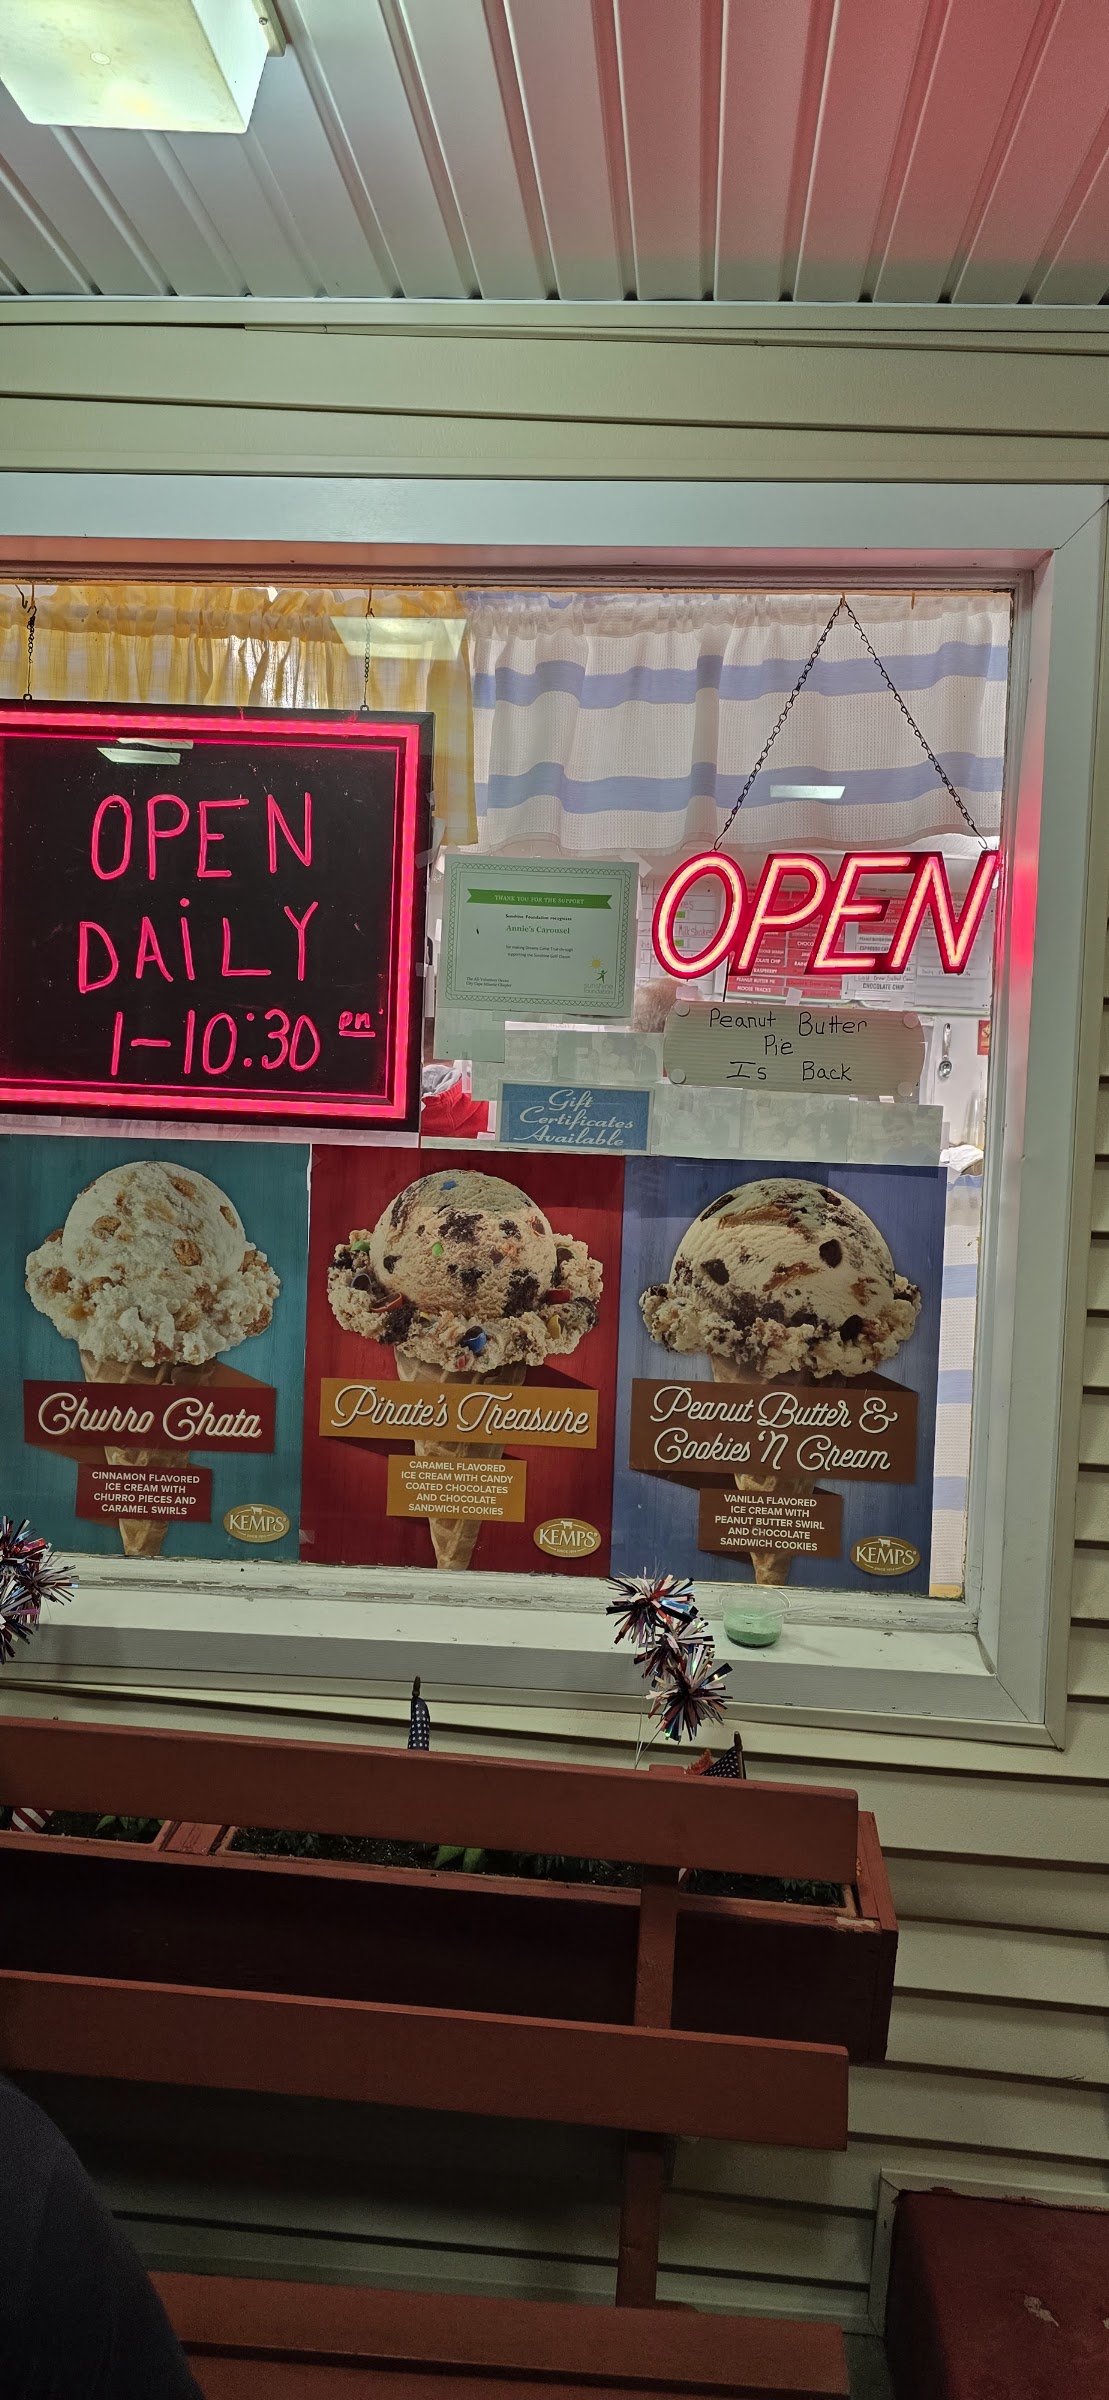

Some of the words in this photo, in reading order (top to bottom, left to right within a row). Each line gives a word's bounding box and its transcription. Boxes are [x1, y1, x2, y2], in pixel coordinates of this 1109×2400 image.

[91, 792, 312, 880] OPEN
[652, 850, 1000, 980] OPEN
[506, 925, 535, 933] Annie's
[536, 926, 570, 934] Carousel
[709, 1008, 776, 1029] Peanut
[798, 1012, 868, 1037] Butter
[765, 1035, 794, 1056] Pie
[726, 1061, 767, 1081] Is
[802, 1061, 852, 1081] Back
[549, 1089, 593, 1111] Gift
[519, 1106, 634, 1130] Certificates
[513, 1125, 624, 1146] Available
[38, 1392, 155, 1435] Churro
[162, 1397, 263, 1441] Chata
[331, 1384, 448, 1427] Pirate's
[457, 1391, 589, 1434] Treasure
[650, 1385, 754, 1423] Peanut
[756, 1391, 851, 1428] Butter
[859, 1397, 898, 1434] &
[654, 1427, 751, 1463] Cookies
[796, 1434, 891, 1471] Cream
[409, 1461, 454, 1471] CARAMEL
[456, 1462, 506, 1473] FLAVORED
[92, 1471, 146, 1482] CINNAMON
[149, 1473, 200, 1484] FLAVORED
[401, 1471, 416, 1480] ICE
[418, 1472, 452, 1481] CREAM
[453, 1473, 478, 1483] WITH
[480, 1474, 513, 1484] CANDY
[105, 1482, 122, 1492] ICE
[123, 1483, 159, 1493] CREAM
[160, 1484, 186, 1494] WITH
[405, 1481, 443, 1492] COATED
[445, 1483, 509, 1494] CHOCOLATES
[93, 1493, 136, 1503] CHURRO
[138, 1494, 173, 1505] PIECES
[174, 1496, 196, 1505] AND
[416, 1493, 437, 1502] AND
[439, 1494, 497, 1505] CHOCOLATE
[724, 1494, 764, 1505] VANILLA
[766, 1497, 817, 1507] FLAVORED
[101, 1504, 149, 1514] CARAMEL
[150, 1505, 188, 1515] SWIRLS
[408, 1503, 460, 1514] SANDWICH
[461, 1505, 504, 1516] COOKIES
[730, 1506, 746, 1515] ICE
[748, 1507, 783, 1516] CREAM
[784, 1509, 810, 1518] WITH
[230, 1514, 285, 1532] KEMPS
[715, 1516, 754, 1526] PEANUT
[756, 1518, 793, 1528] BUTTER
[795, 1520, 825, 1530] SWIRL
[539, 1529, 596, 1547] KEMPS
[728, 1527, 750, 1537] AND
[751, 1528, 811, 1540] CHOCOLATE
[720, 1537, 773, 1549] SANDWICH
[774, 1540, 818, 1551] COOKIES
[856, 1546, 915, 1565] KEMPS
